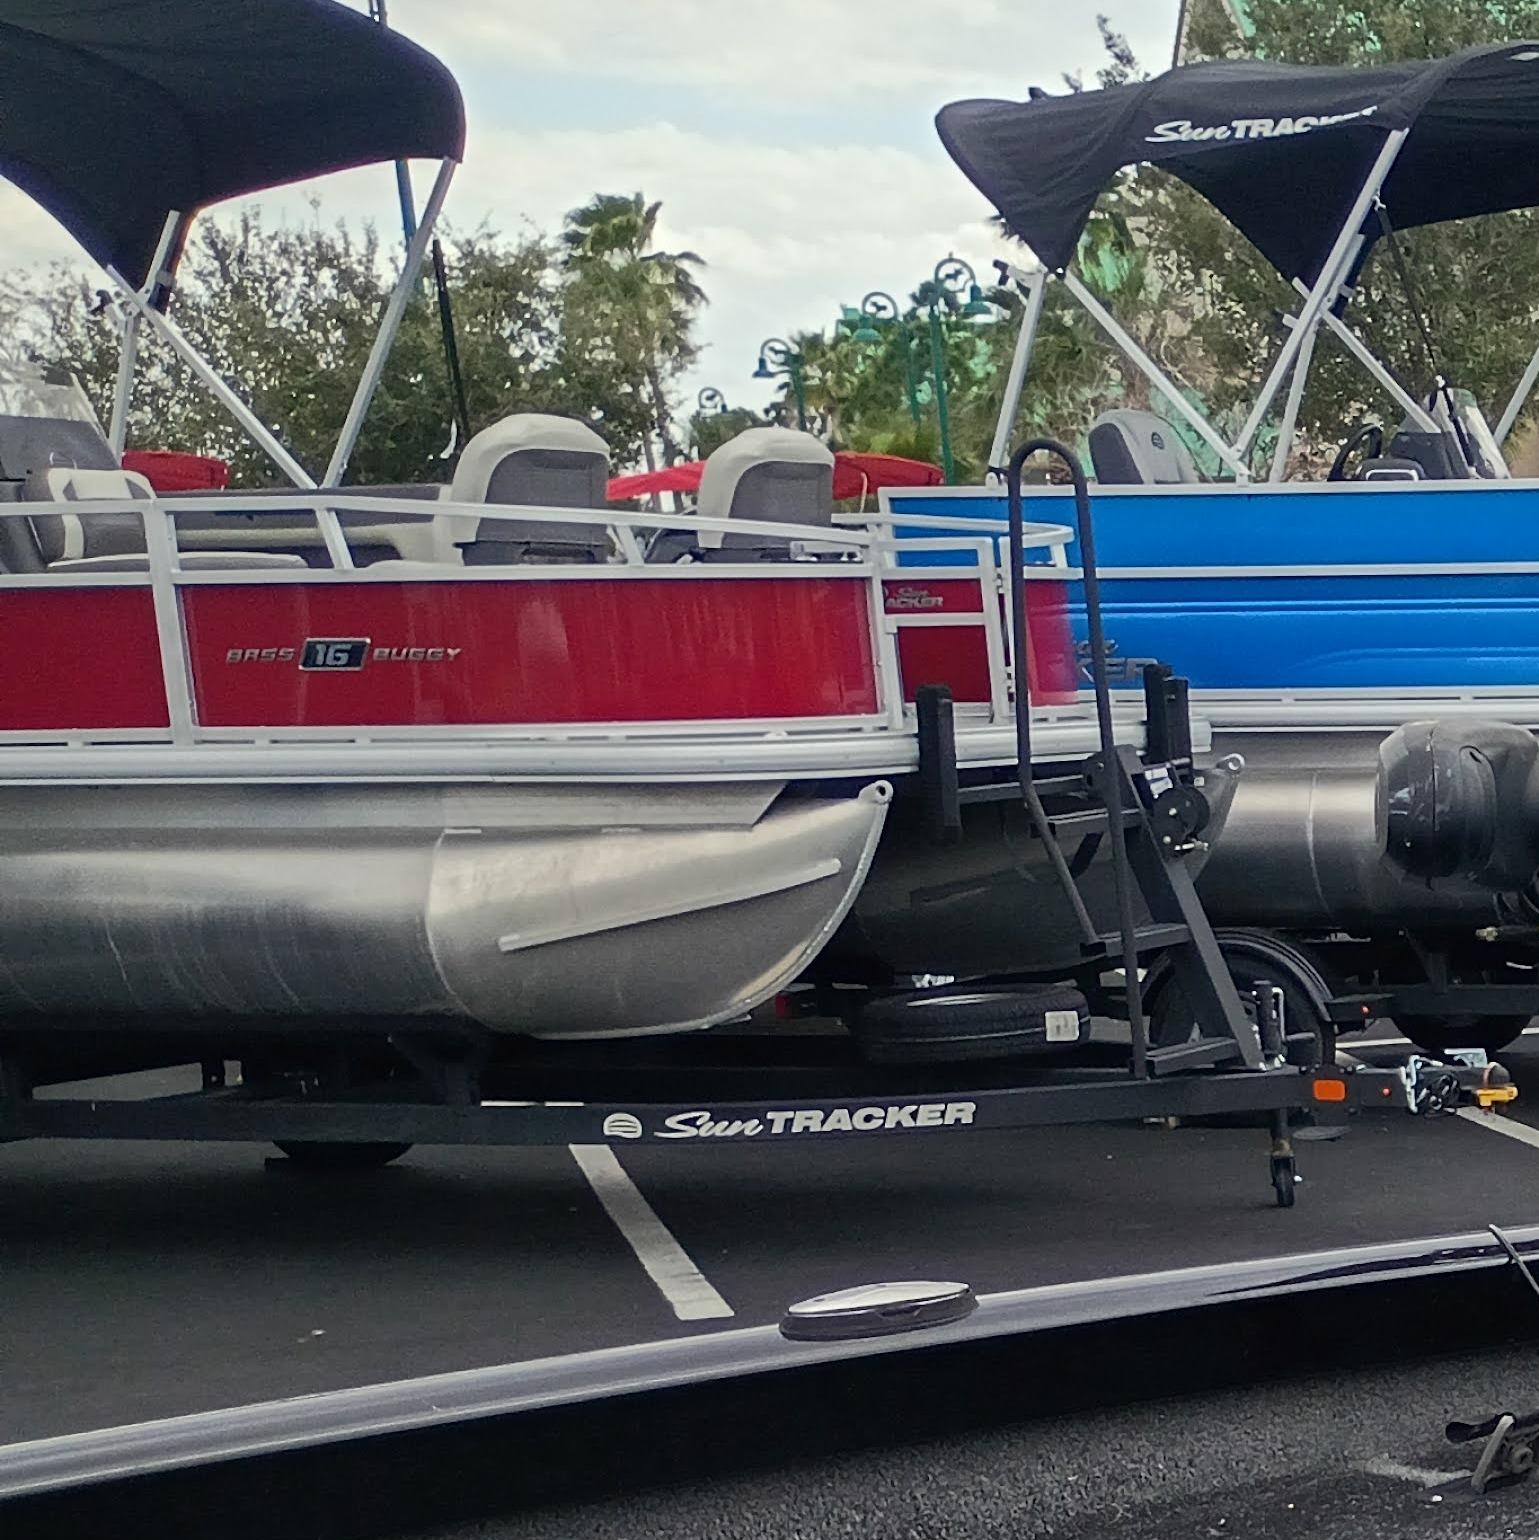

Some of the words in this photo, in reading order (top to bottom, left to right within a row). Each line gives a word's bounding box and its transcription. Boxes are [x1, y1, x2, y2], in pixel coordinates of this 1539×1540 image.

[1145, 120, 1231, 142] Sun
[226, 647, 296, 663] BASS
[314, 643, 353, 667] 16
[372, 647, 462, 662] BUGGY
[654, 1110, 764, 1139] Sun
[765, 1101, 977, 1135] TRACKER
